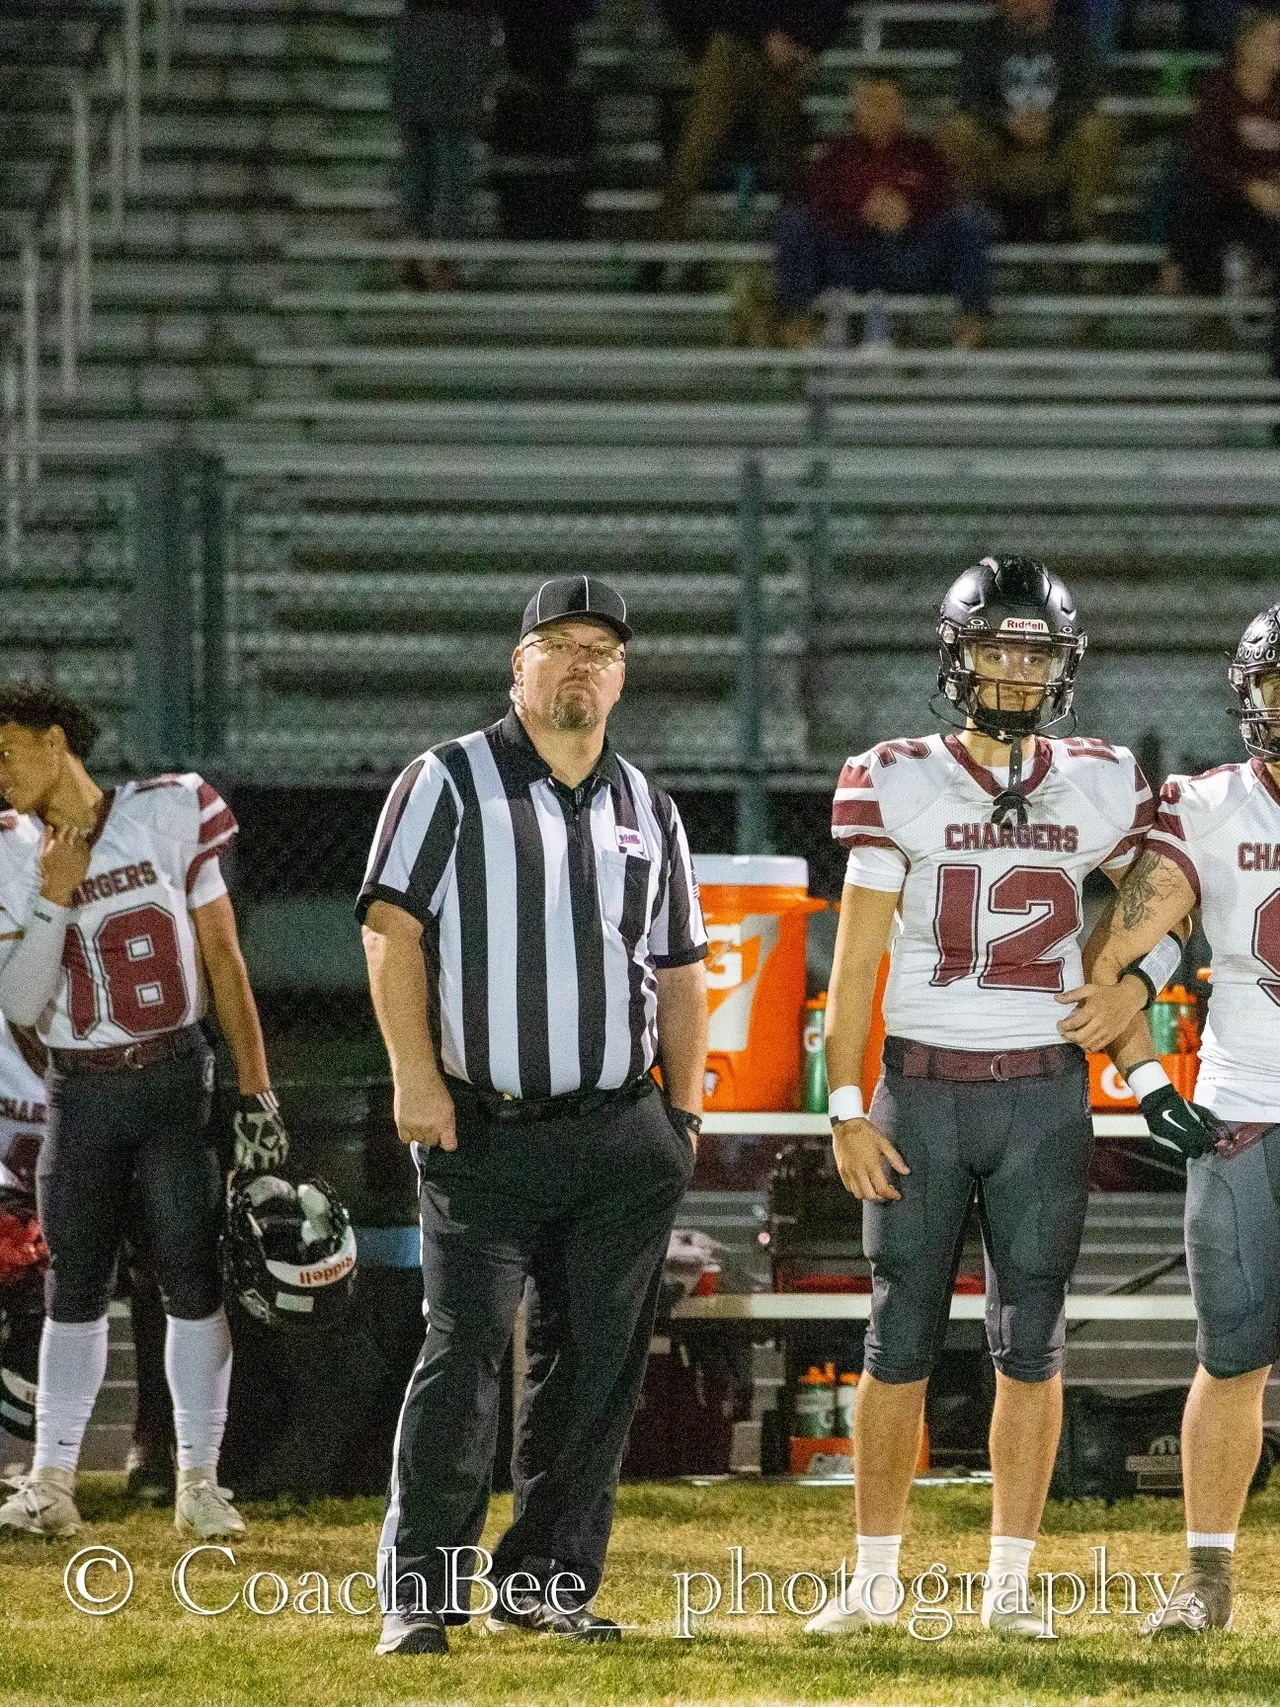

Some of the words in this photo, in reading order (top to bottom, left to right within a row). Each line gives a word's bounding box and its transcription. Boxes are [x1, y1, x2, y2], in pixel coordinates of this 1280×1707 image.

[1006, 620, 1044, 631] Riddell
[945, 822, 1080, 854] CHARGERS
[928, 863, 1083, 994] 12
[61, 901, 192, 1041] 18
